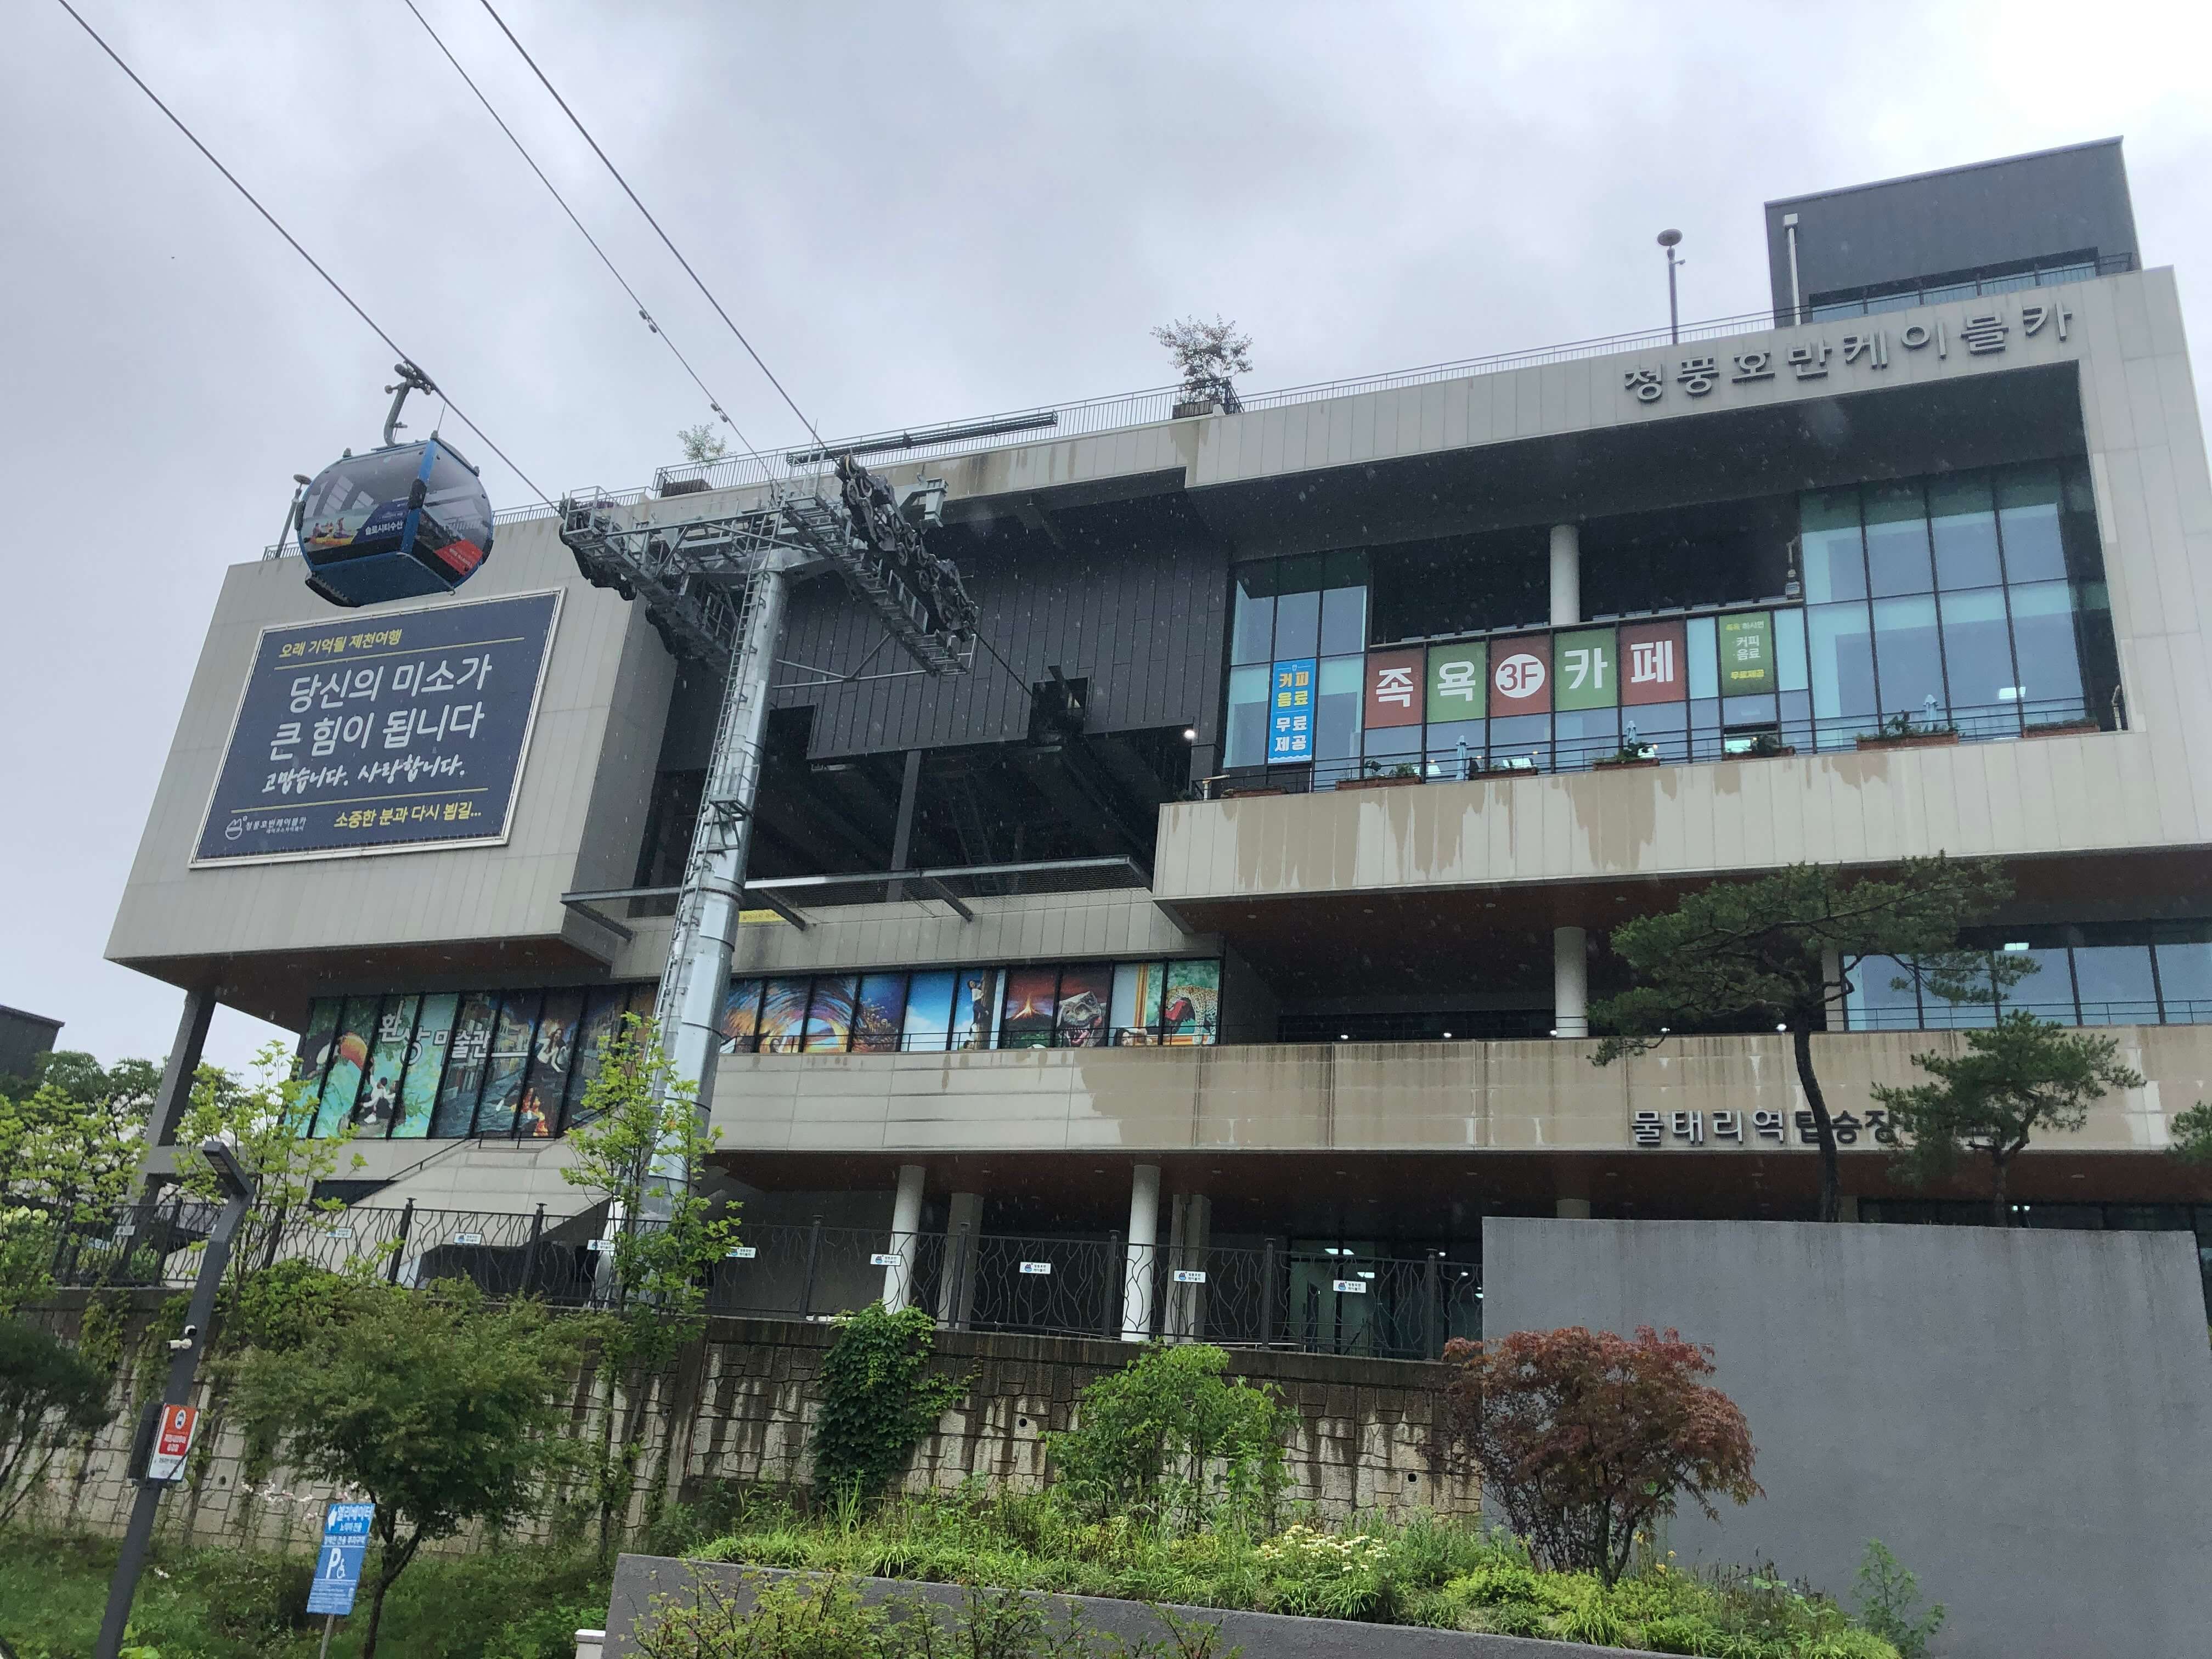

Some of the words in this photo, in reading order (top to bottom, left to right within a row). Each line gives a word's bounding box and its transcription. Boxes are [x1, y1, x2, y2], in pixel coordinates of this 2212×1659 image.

[1624, 300, 2072, 403] 청풍호반케이블카
[281, 644, 305, 657] 오래
[308, 637, 346, 653] 기억될
[349, 629, 402, 649] 제천여행
[1736, 635, 1759, 647] 커피
[1737, 648, 1761, 661] 음료
[290, 666, 383, 714] 당신의
[392, 653, 492, 697] 미소가
[1279, 671, 1309, 688] 커피
[1278, 690, 1308, 707] 음료
[270, 722, 301, 761] 큰
[312, 713, 375, 756] 힘이
[382, 702, 485, 749] 됩니다
[1276, 716, 1307, 732] 무료
[1274, 735, 1307, 752] 제공
[262, 766, 349, 794] 고맙습니다.
[357, 754, 466, 783] 사랑합니다.
[334, 808, 376, 829] 소중한
[380, 805, 409, 825] 분과
[411, 804, 440, 822] 다시
